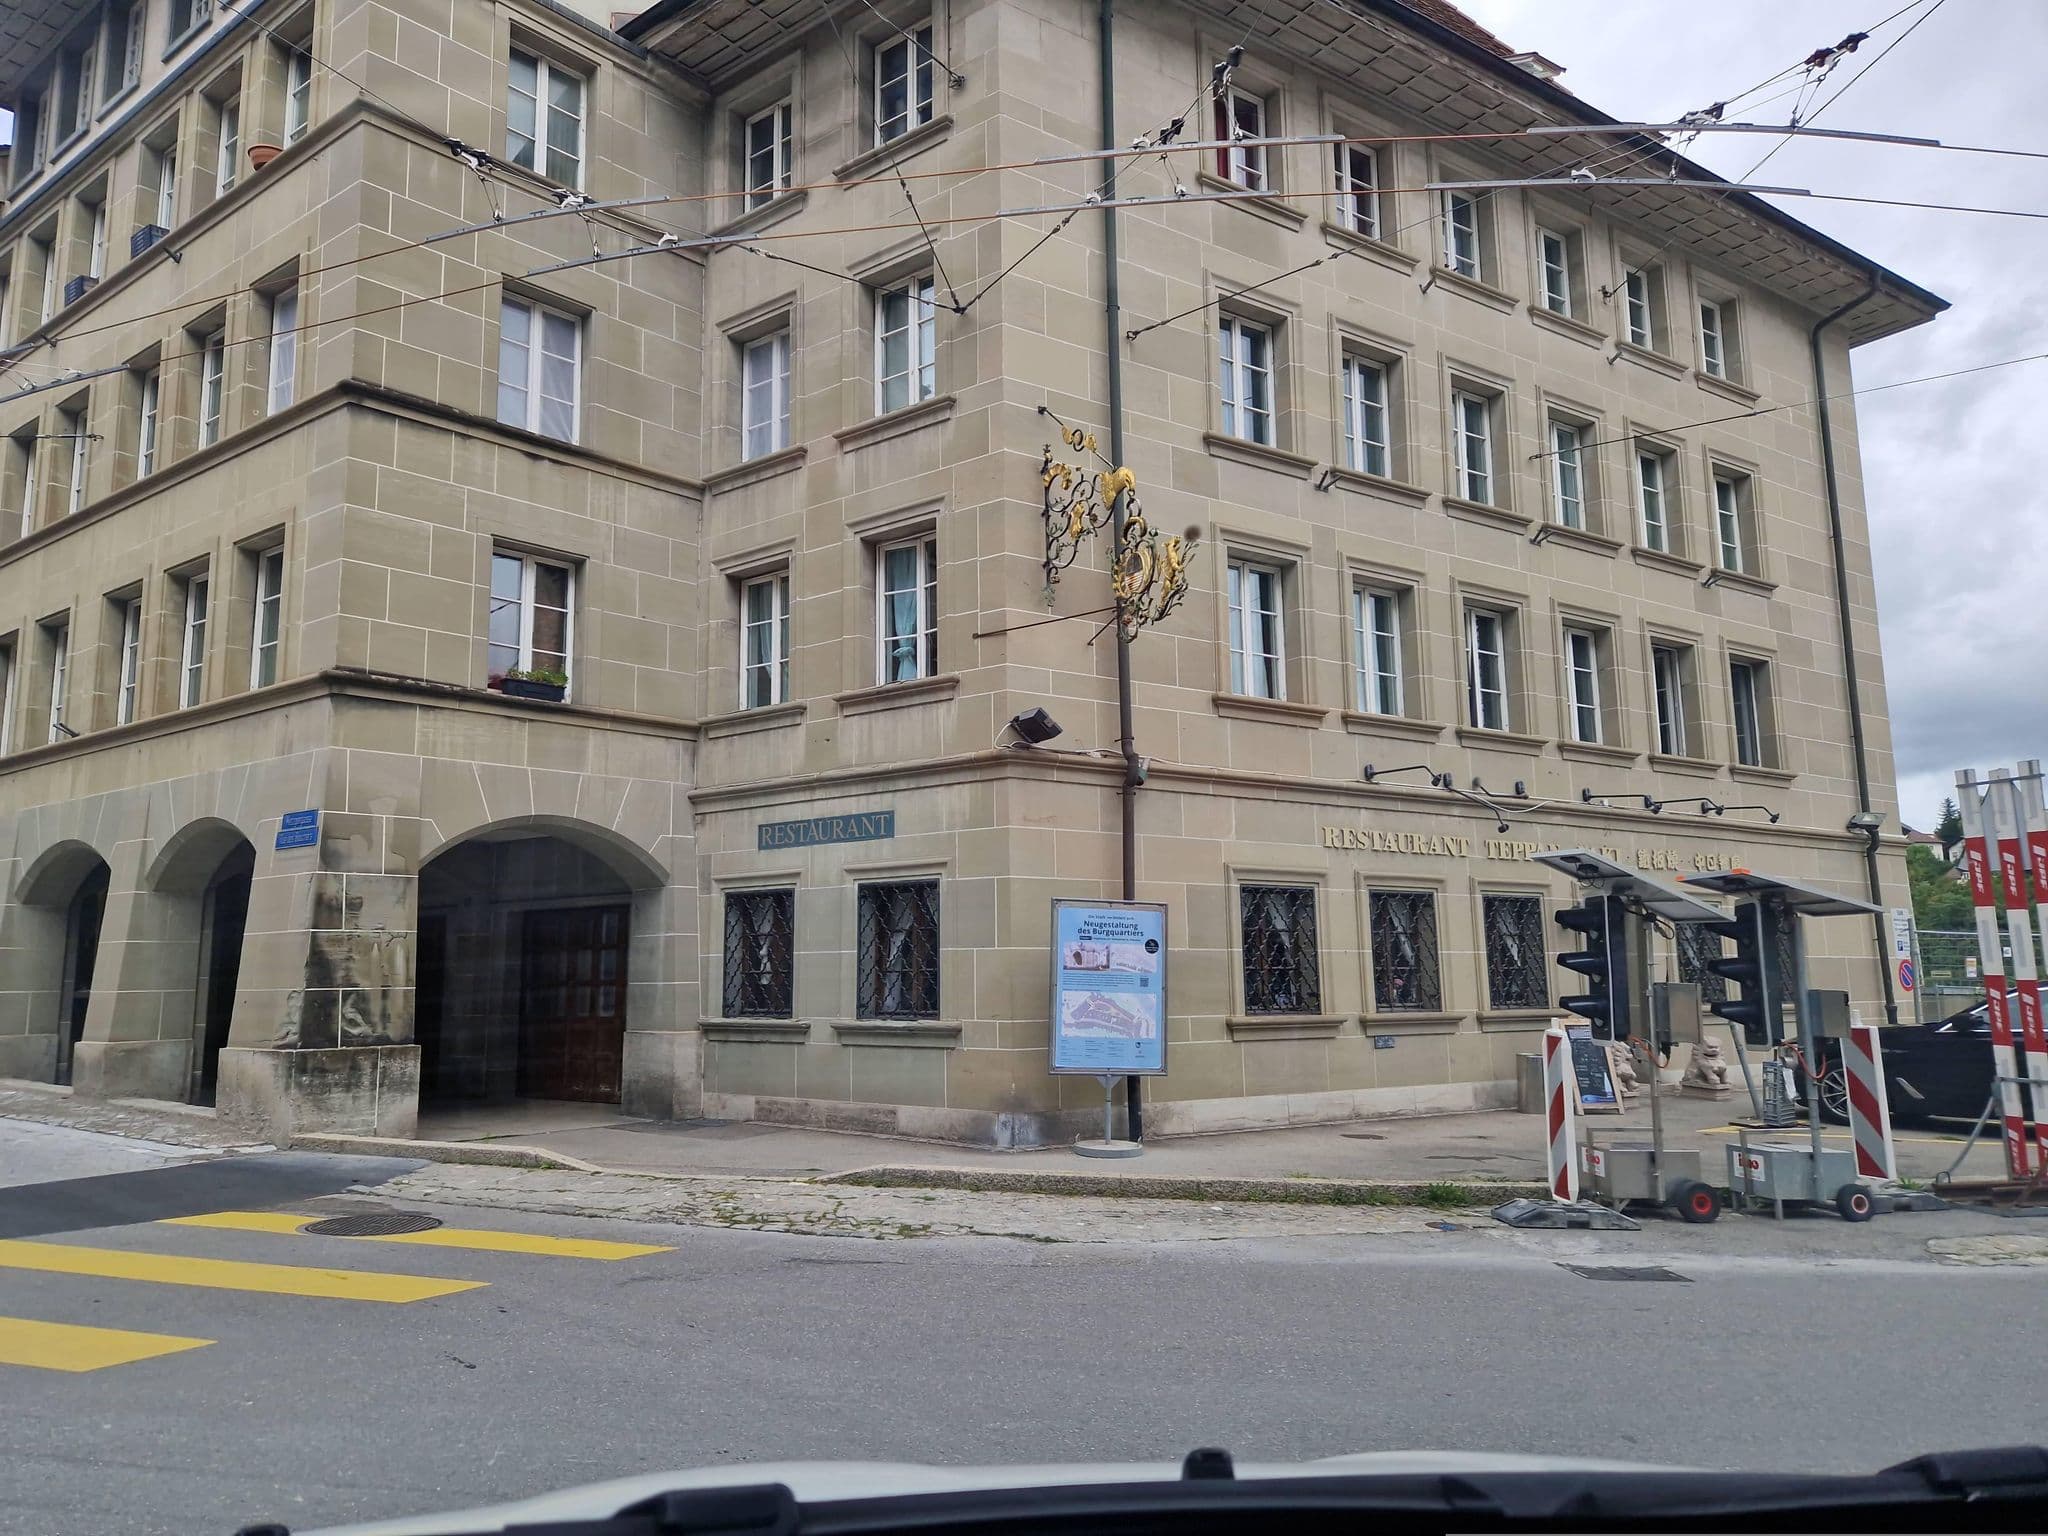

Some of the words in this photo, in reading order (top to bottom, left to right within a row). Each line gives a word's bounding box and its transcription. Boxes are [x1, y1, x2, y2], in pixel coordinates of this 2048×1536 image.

[762, 814, 889, 846] RESTAURANT
[1322, 826, 1471, 857] RESTAURANT
[1083, 920, 1139, 931] Neugestaltung
[1092, 928, 1144, 937] Burgquartiers
